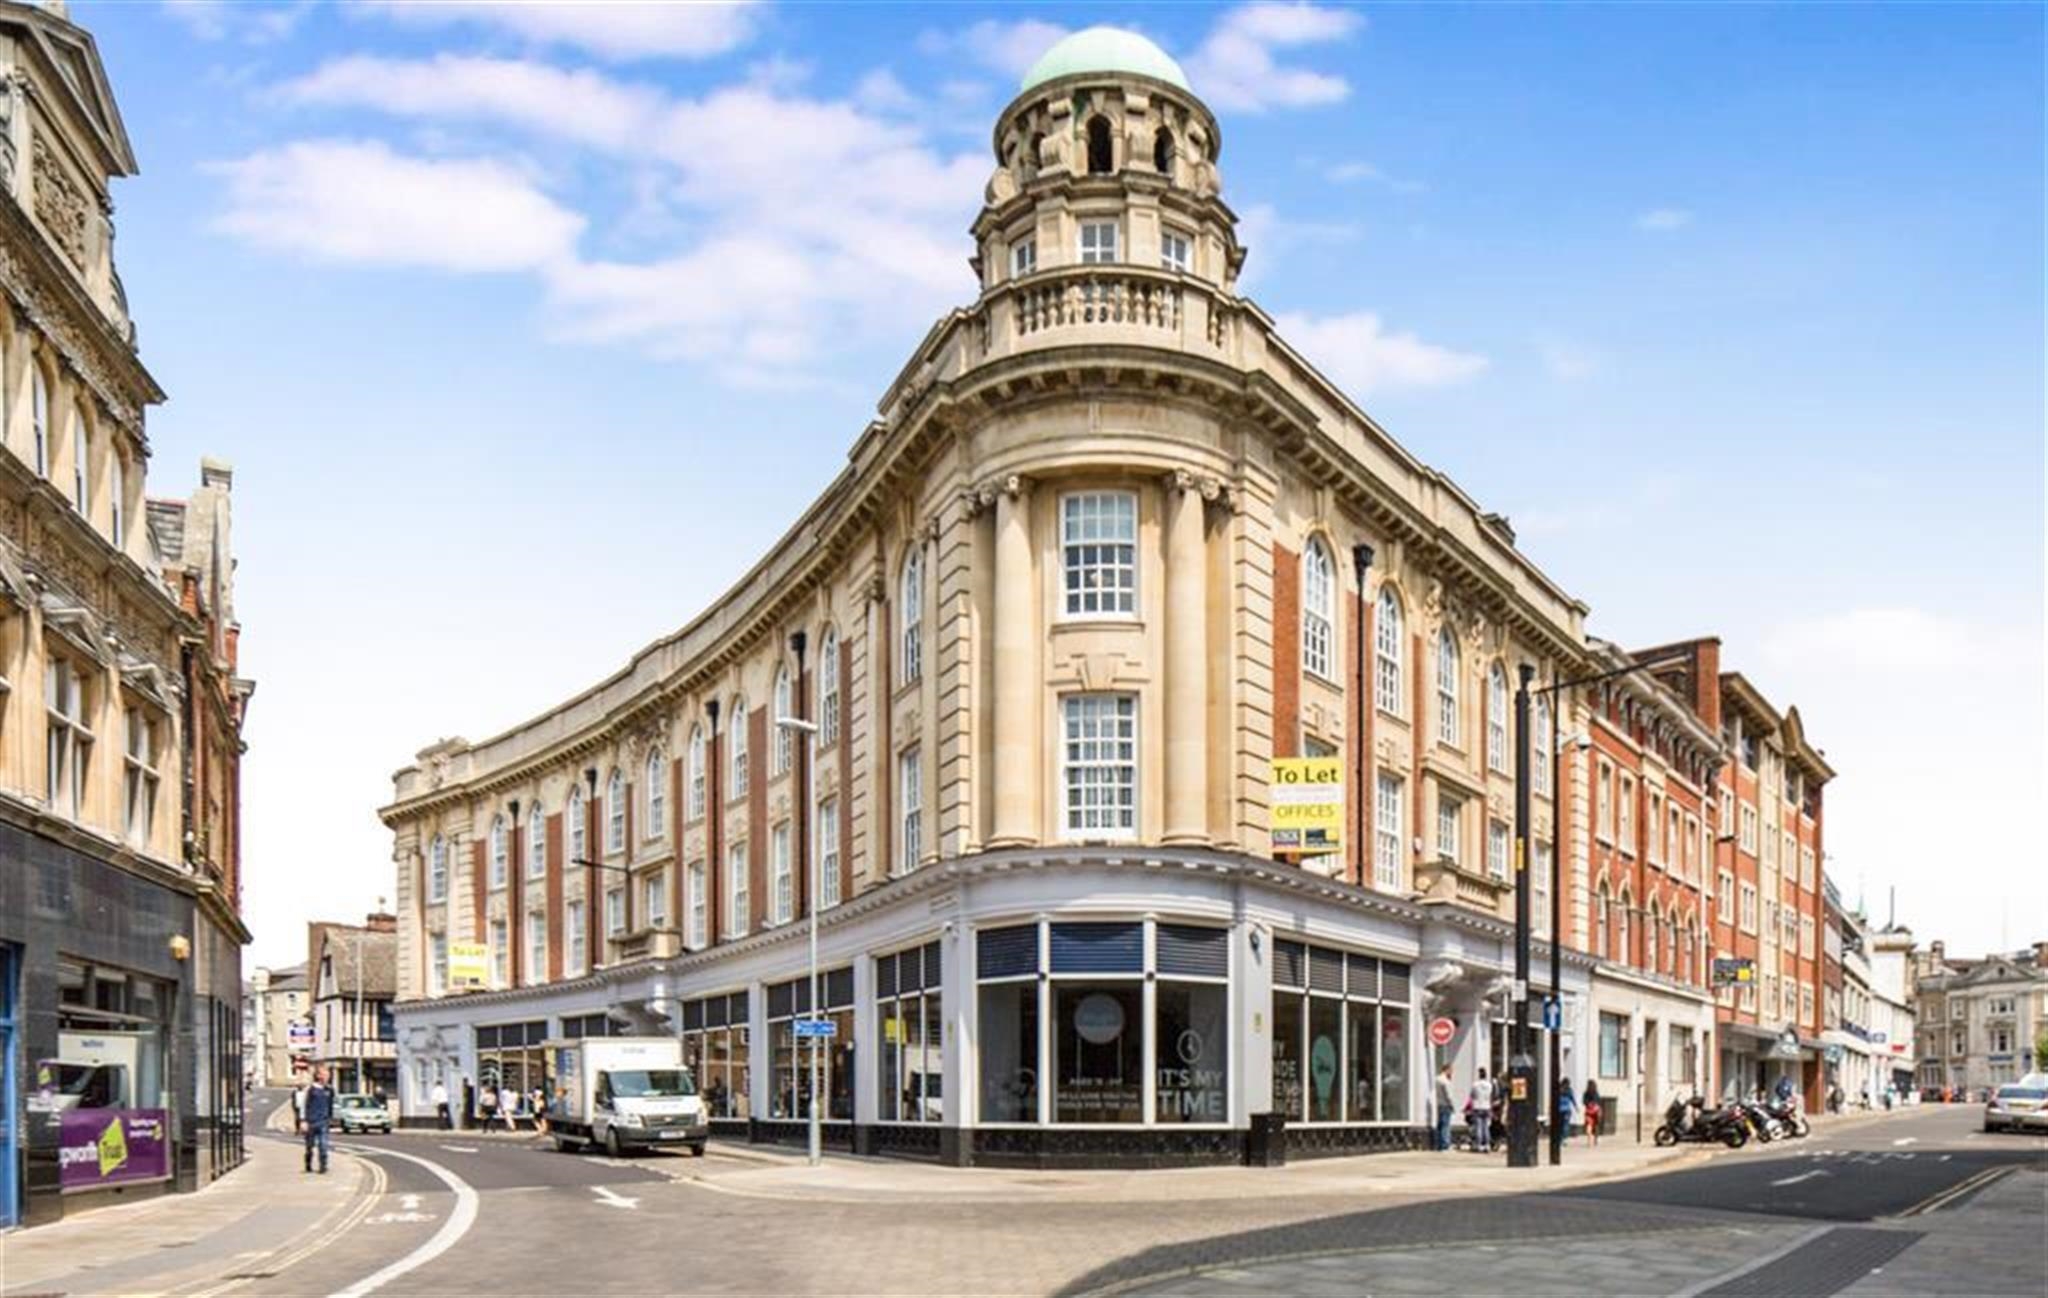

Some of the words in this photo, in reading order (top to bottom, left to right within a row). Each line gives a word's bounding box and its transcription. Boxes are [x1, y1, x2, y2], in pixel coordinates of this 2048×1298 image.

[1273, 766, 1298, 784] To
[1304, 766, 1338, 784] Let
[1276, 803, 1335, 819] OFFICES
[1158, 1069, 1191, 1087] IT'S
[1195, 1070, 1223, 1087] MY
[1158, 1090, 1223, 1115] TIME
